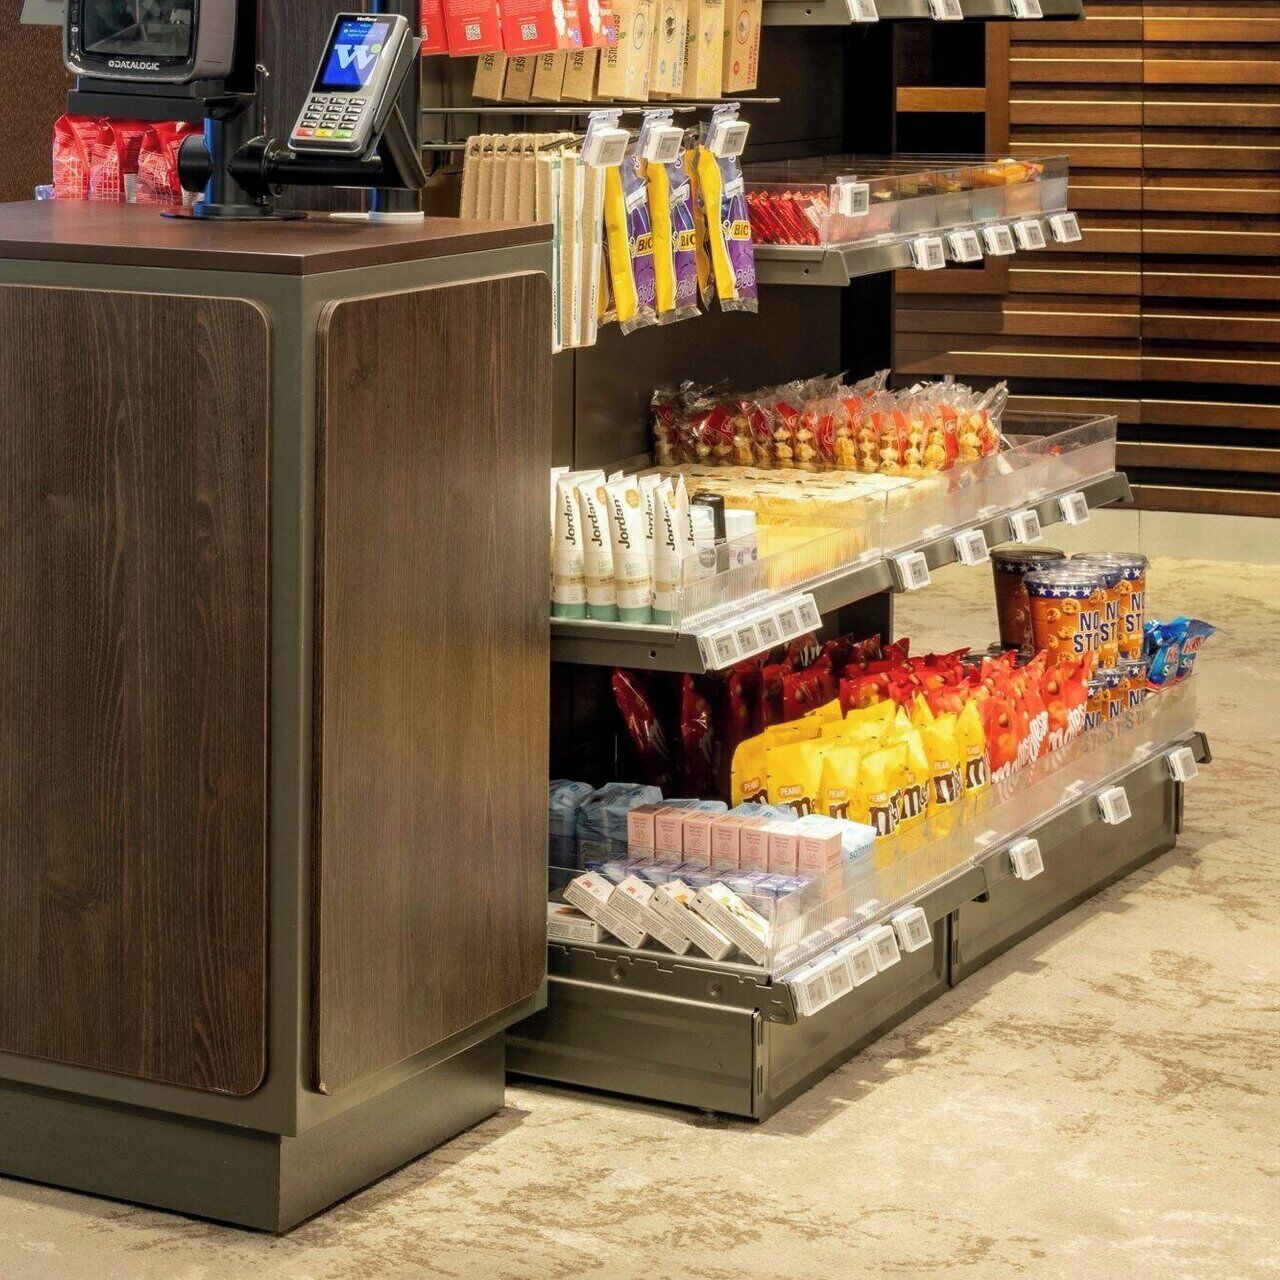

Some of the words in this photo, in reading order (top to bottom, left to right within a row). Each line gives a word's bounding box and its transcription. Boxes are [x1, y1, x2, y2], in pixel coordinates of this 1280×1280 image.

[115, 60, 160, 70] DATALOGIC
[565, 495, 576, 546] Jordan
[589, 497, 603, 547] Jordan
[614, 500, 631, 549] Jordan
[662, 506, 675, 551] Jordan
